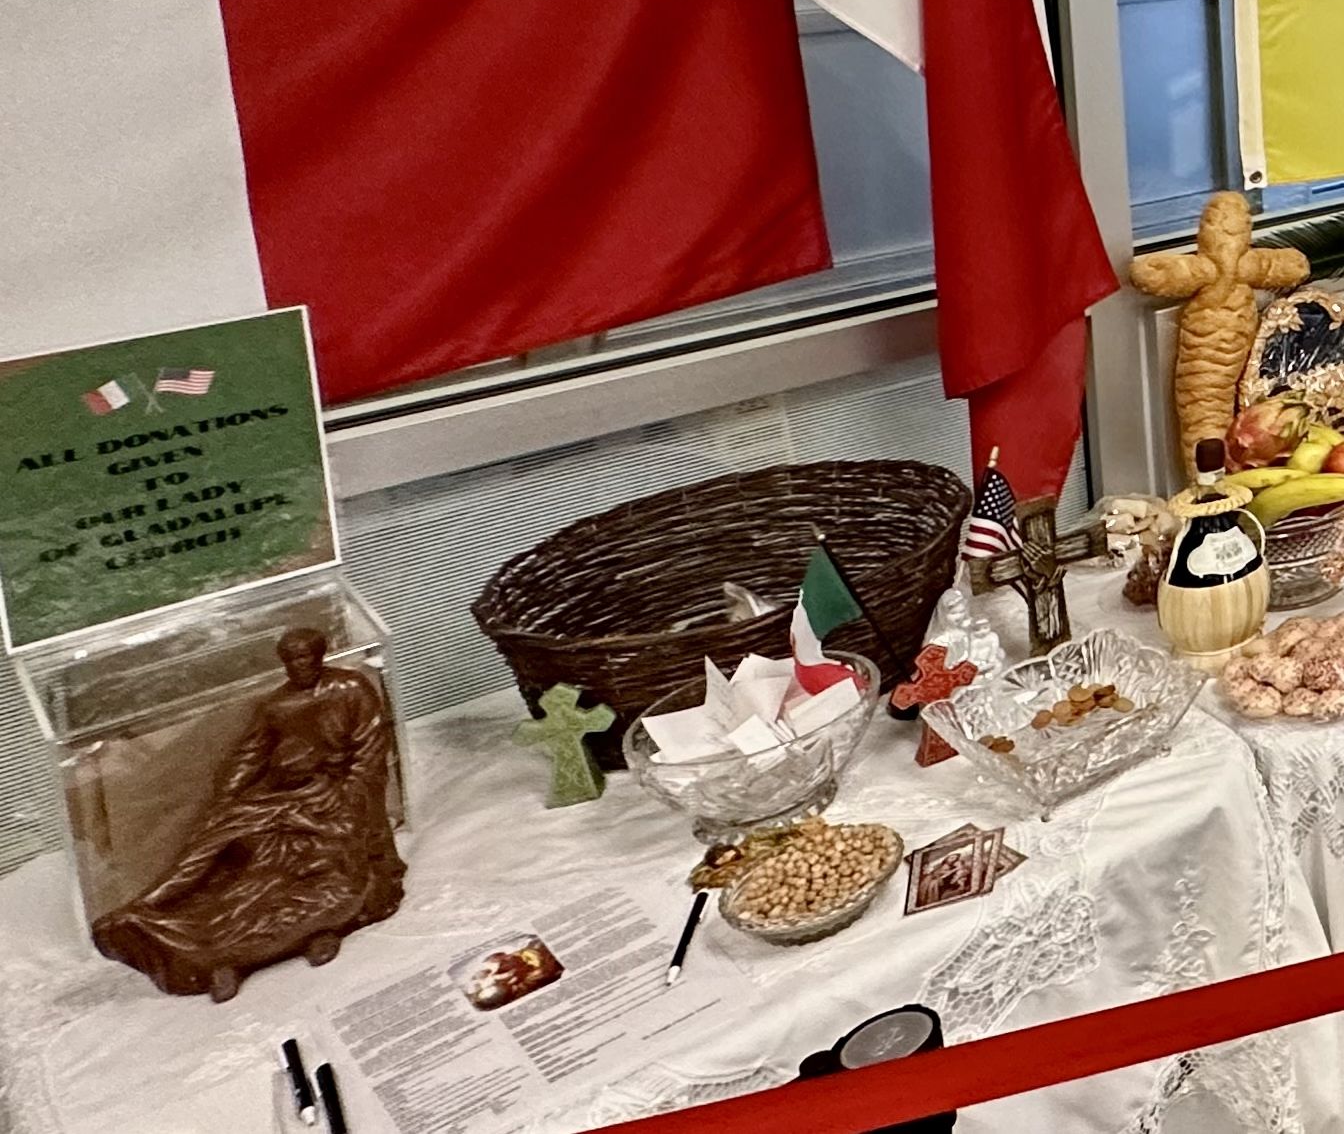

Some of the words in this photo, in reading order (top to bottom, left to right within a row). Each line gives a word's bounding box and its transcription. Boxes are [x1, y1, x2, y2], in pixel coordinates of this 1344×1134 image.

[16, 448, 84, 474] ALL
[95, 404, 290, 456] DONATIONS
[106, 445, 204, 476] GIVEN
[142, 471, 191, 492] TO
[75, 503, 147, 531] OUR
[156, 479, 244, 513] LADY
